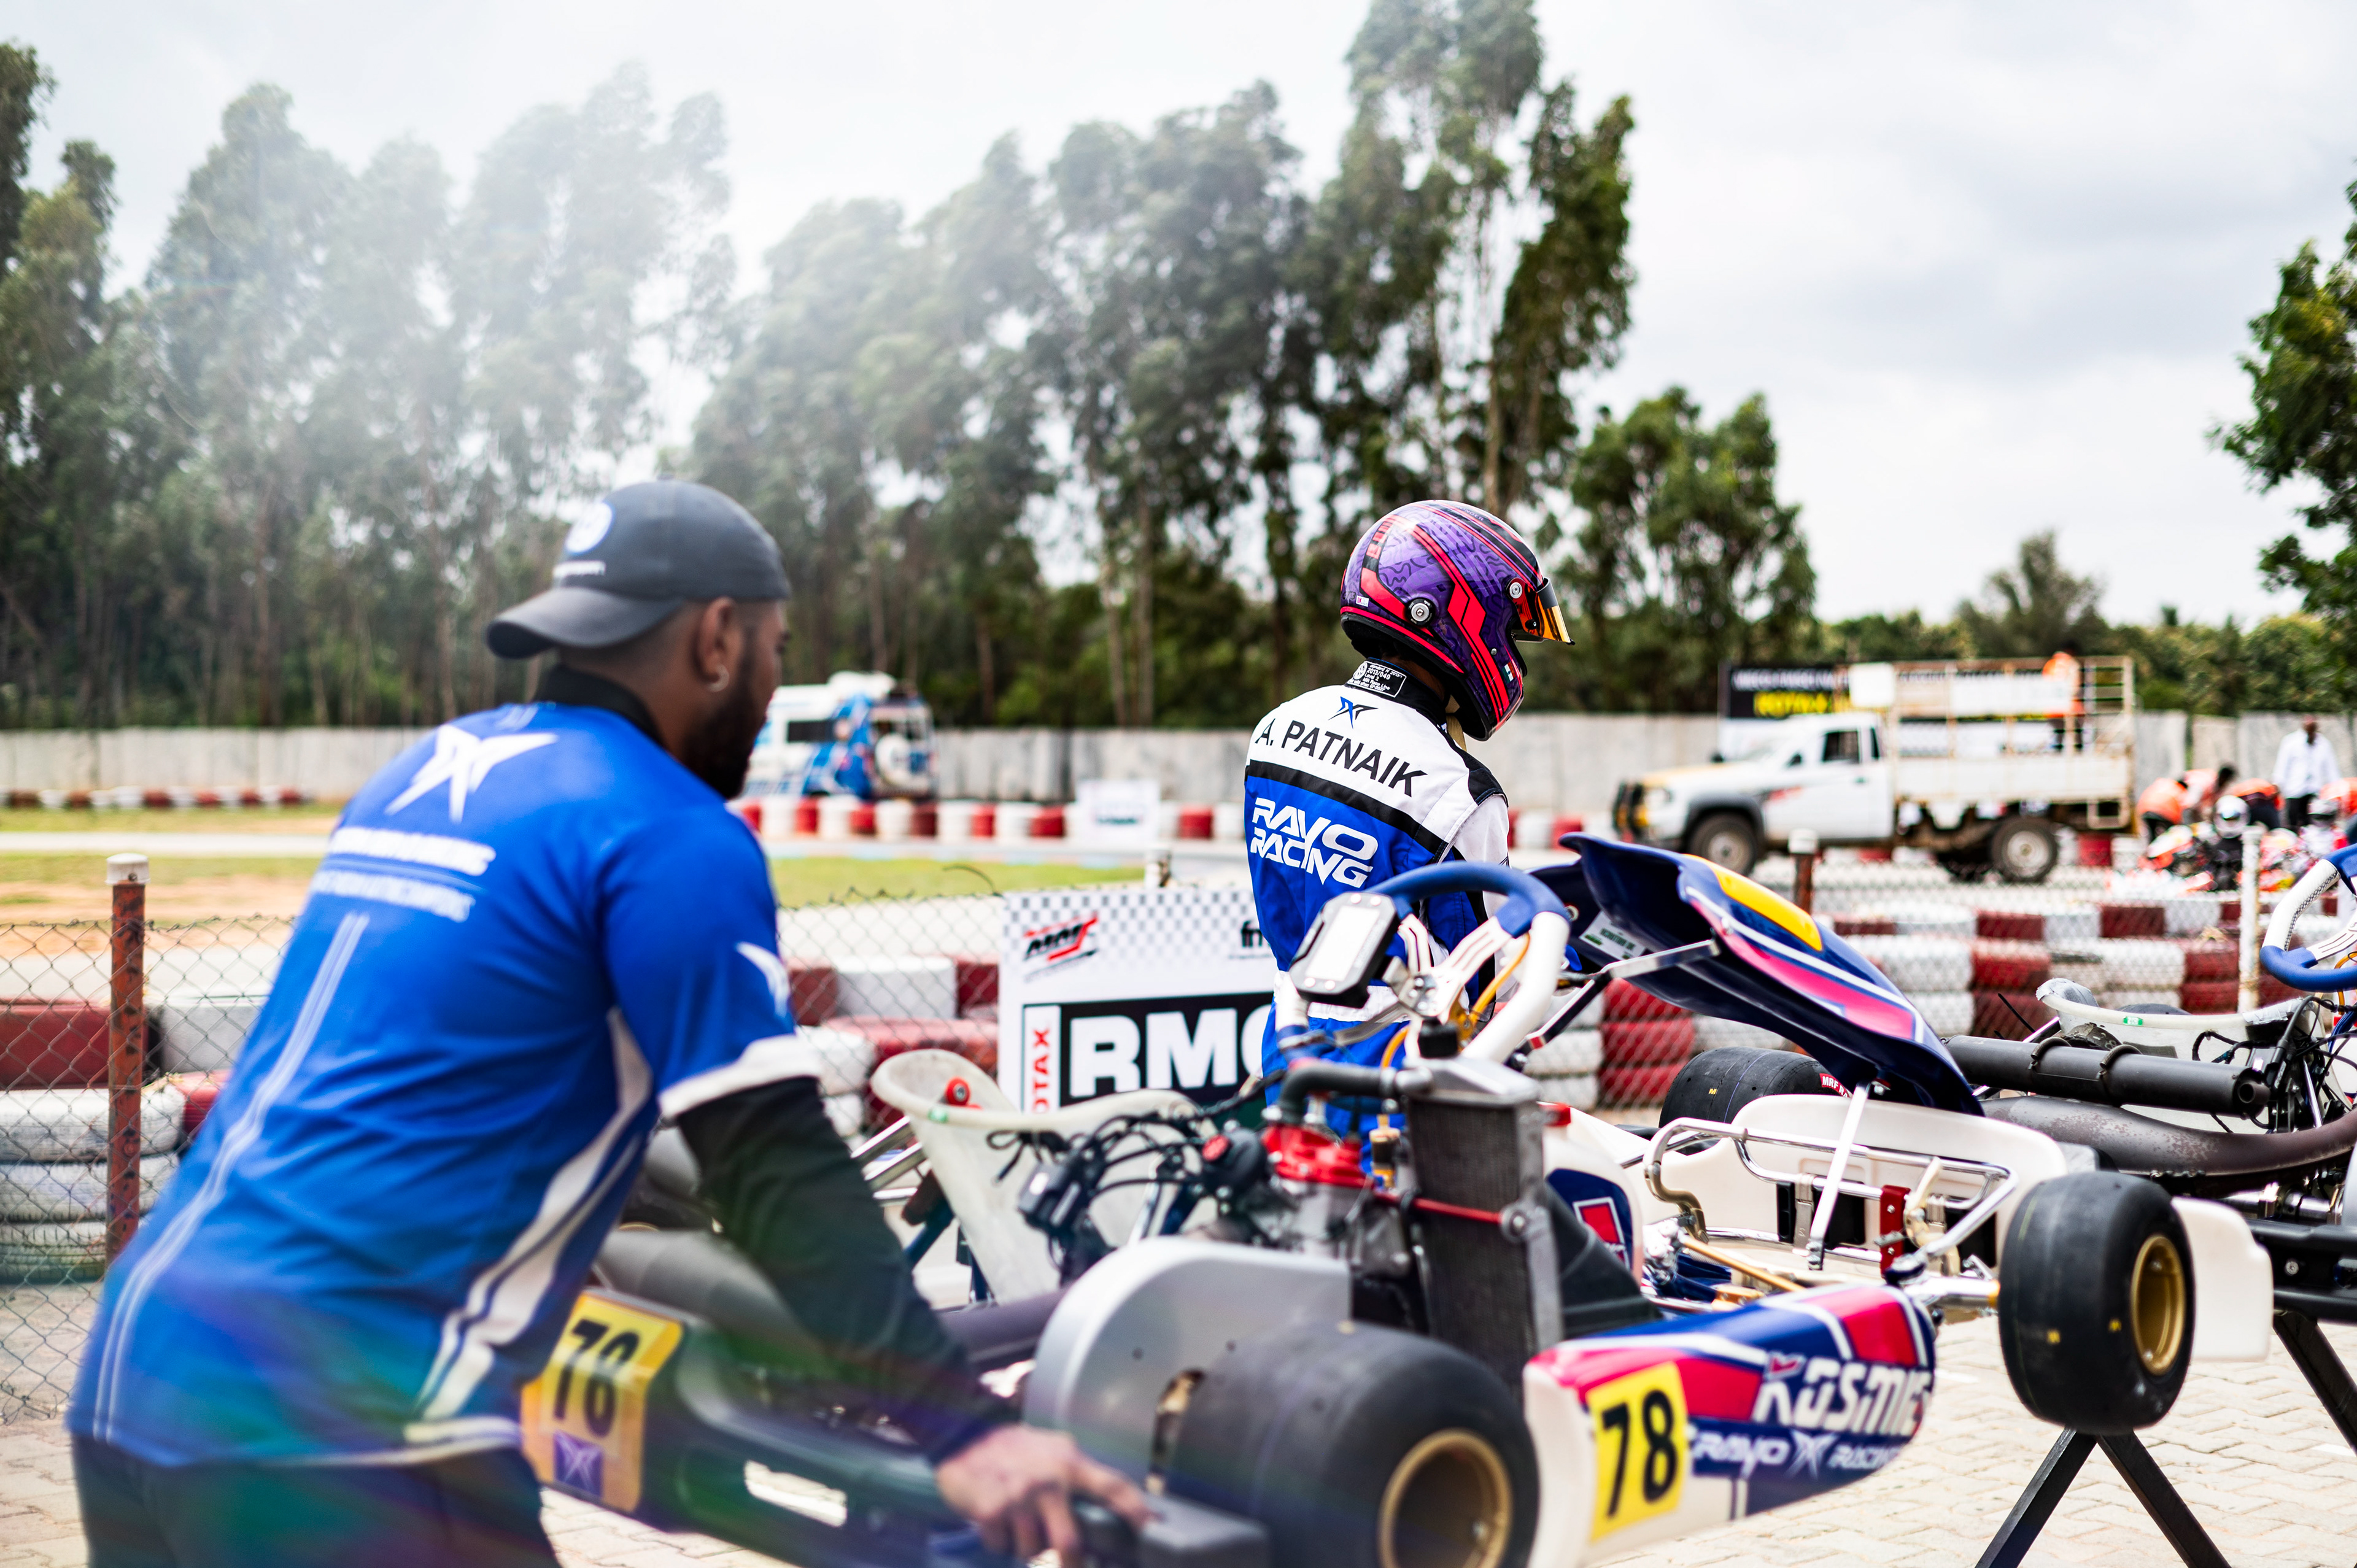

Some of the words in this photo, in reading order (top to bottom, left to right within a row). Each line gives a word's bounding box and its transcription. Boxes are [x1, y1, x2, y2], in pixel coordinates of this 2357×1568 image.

[1366, 668, 1391, 680] 2013/049
[1255, 718, 1274, 746] A.
[1281, 720, 1428, 798] PATNAIK
[1250, 827, 1374, 888] RACING
[1822, 1076, 1839, 1089] MRF
[555, 1318, 640, 1439] 78
[1602, 1389, 1679, 1520] 78
